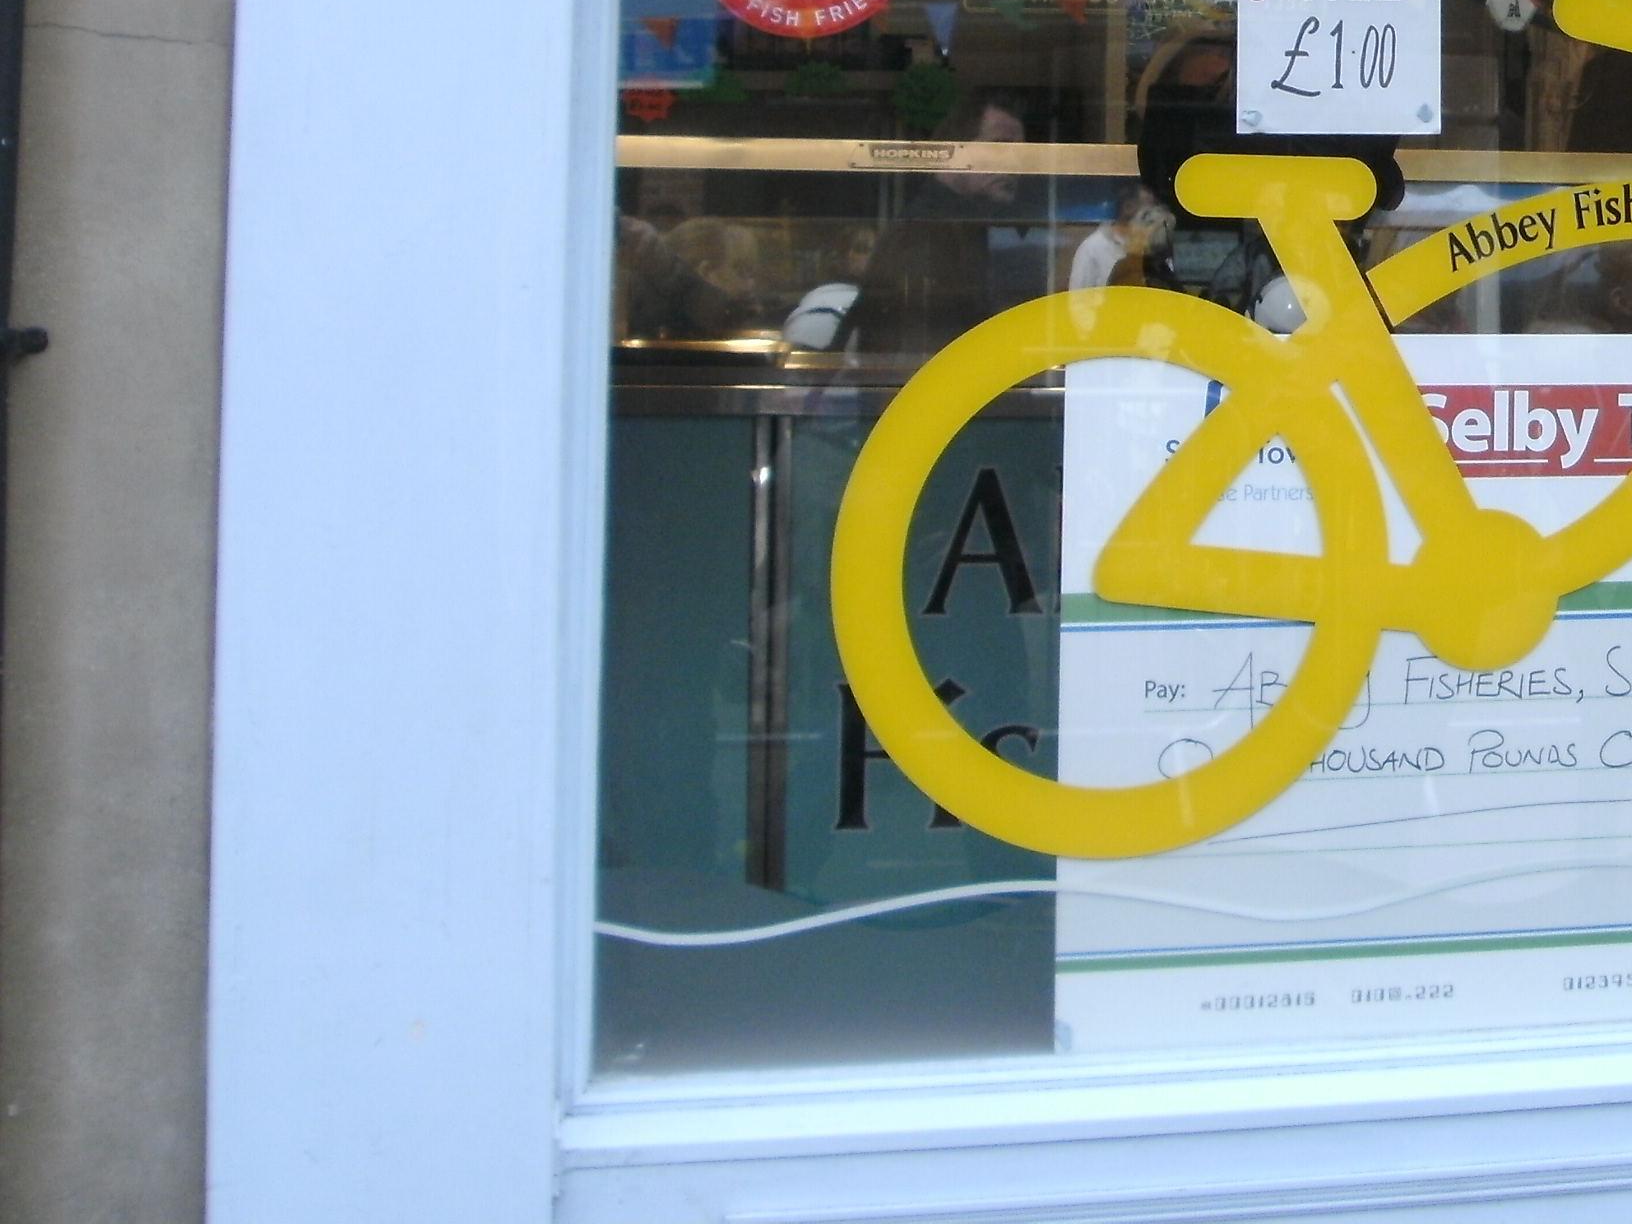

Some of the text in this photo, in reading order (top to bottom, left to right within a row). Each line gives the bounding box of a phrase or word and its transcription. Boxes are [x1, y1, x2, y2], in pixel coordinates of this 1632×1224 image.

[873, 148, 950, 159] HOPKINS
[1447, 208, 1556, 273] Abbey
[1419, 388, 1601, 469] Selby
[1144, 679, 1186, 704] Pay:
[1309, 745, 1446, 774] HOUSAND
